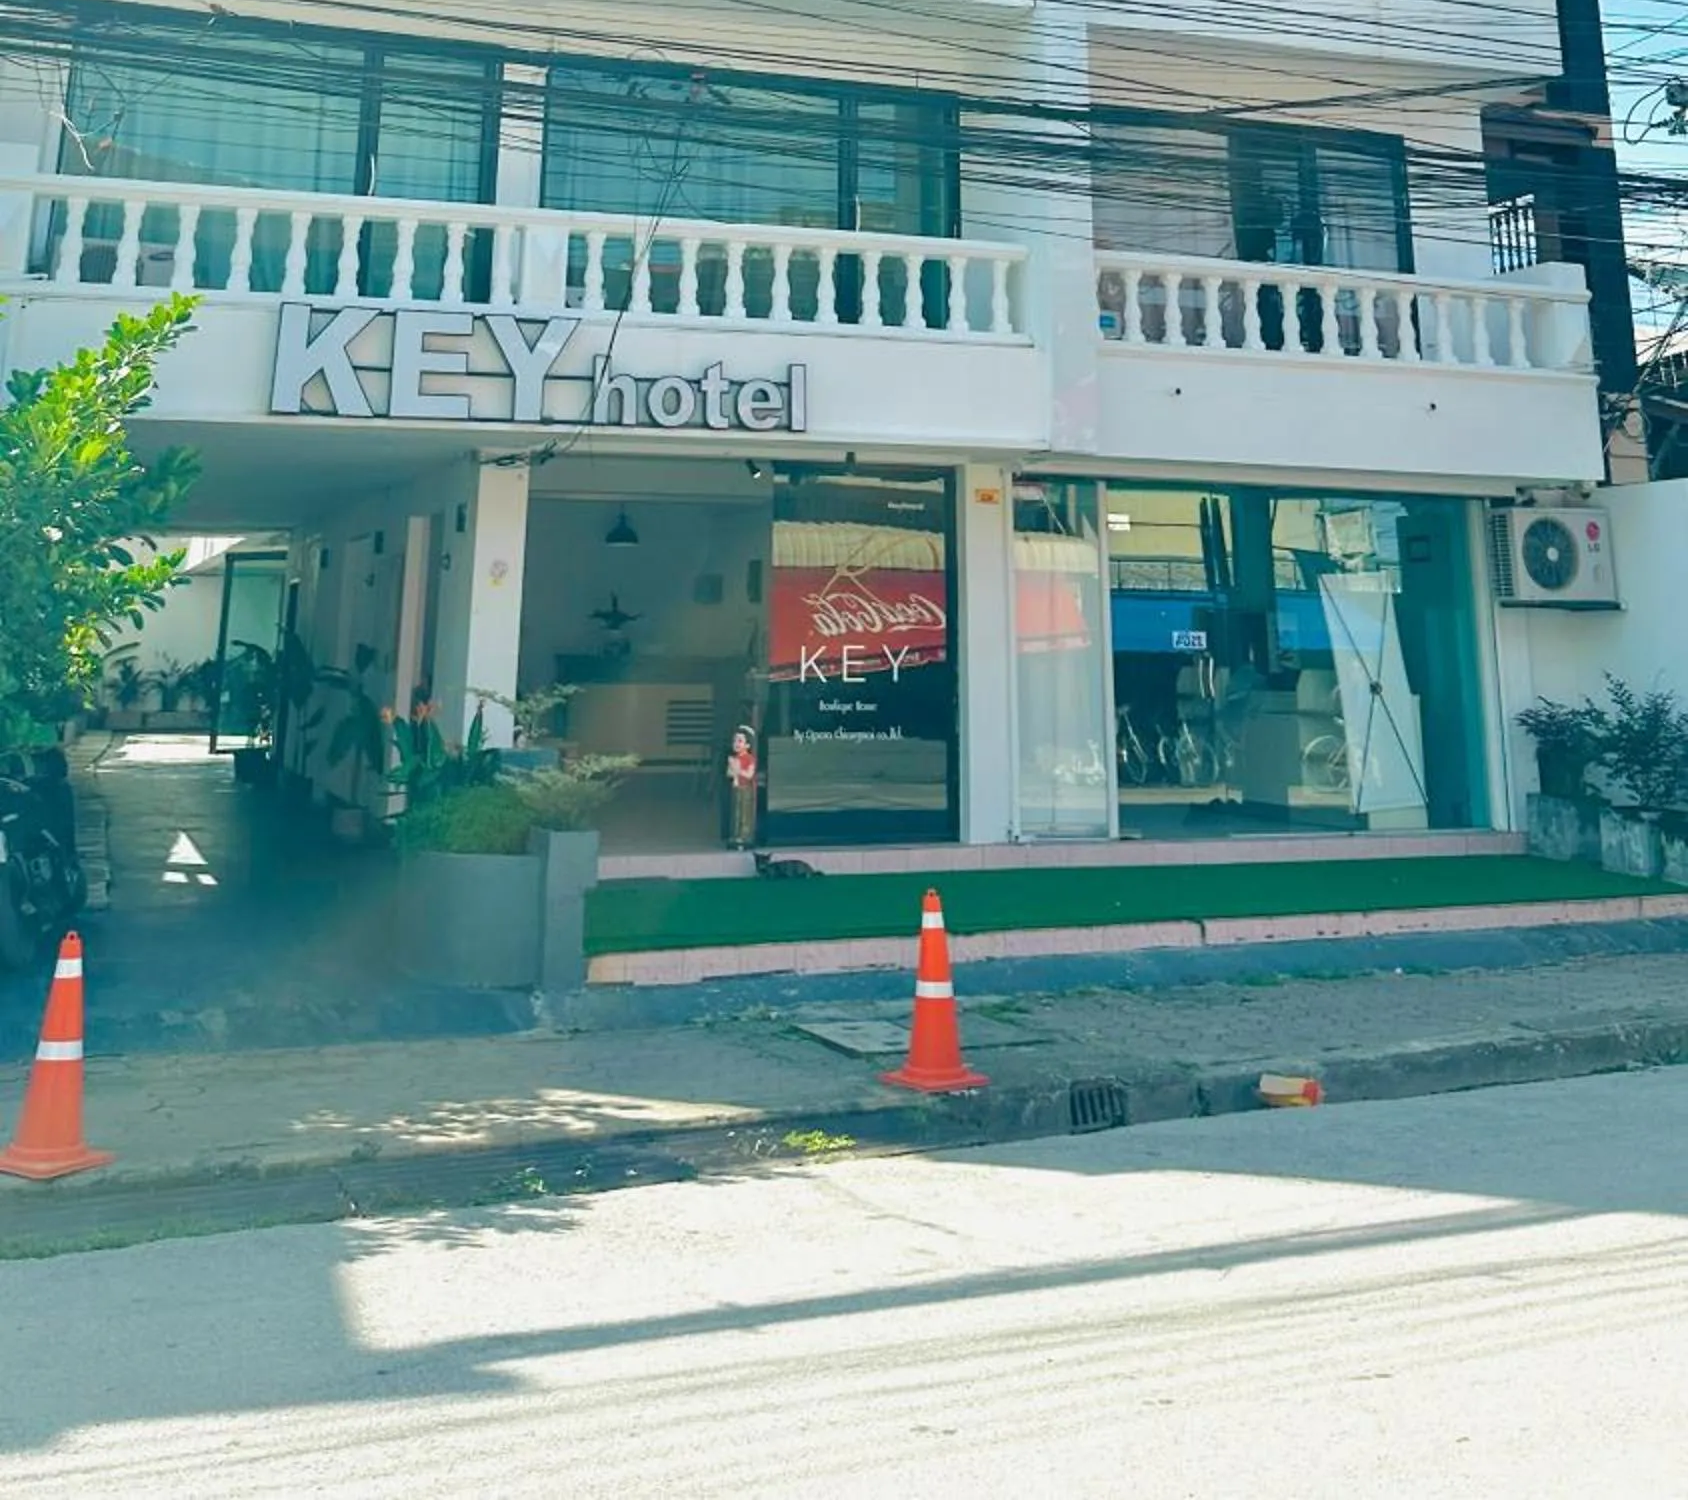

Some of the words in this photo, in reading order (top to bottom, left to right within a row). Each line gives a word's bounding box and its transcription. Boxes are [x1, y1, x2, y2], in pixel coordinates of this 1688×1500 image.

[271, 302, 581, 422] KEY
[592, 355, 807, 432] hotel
[801, 644, 909, 683] KEY
